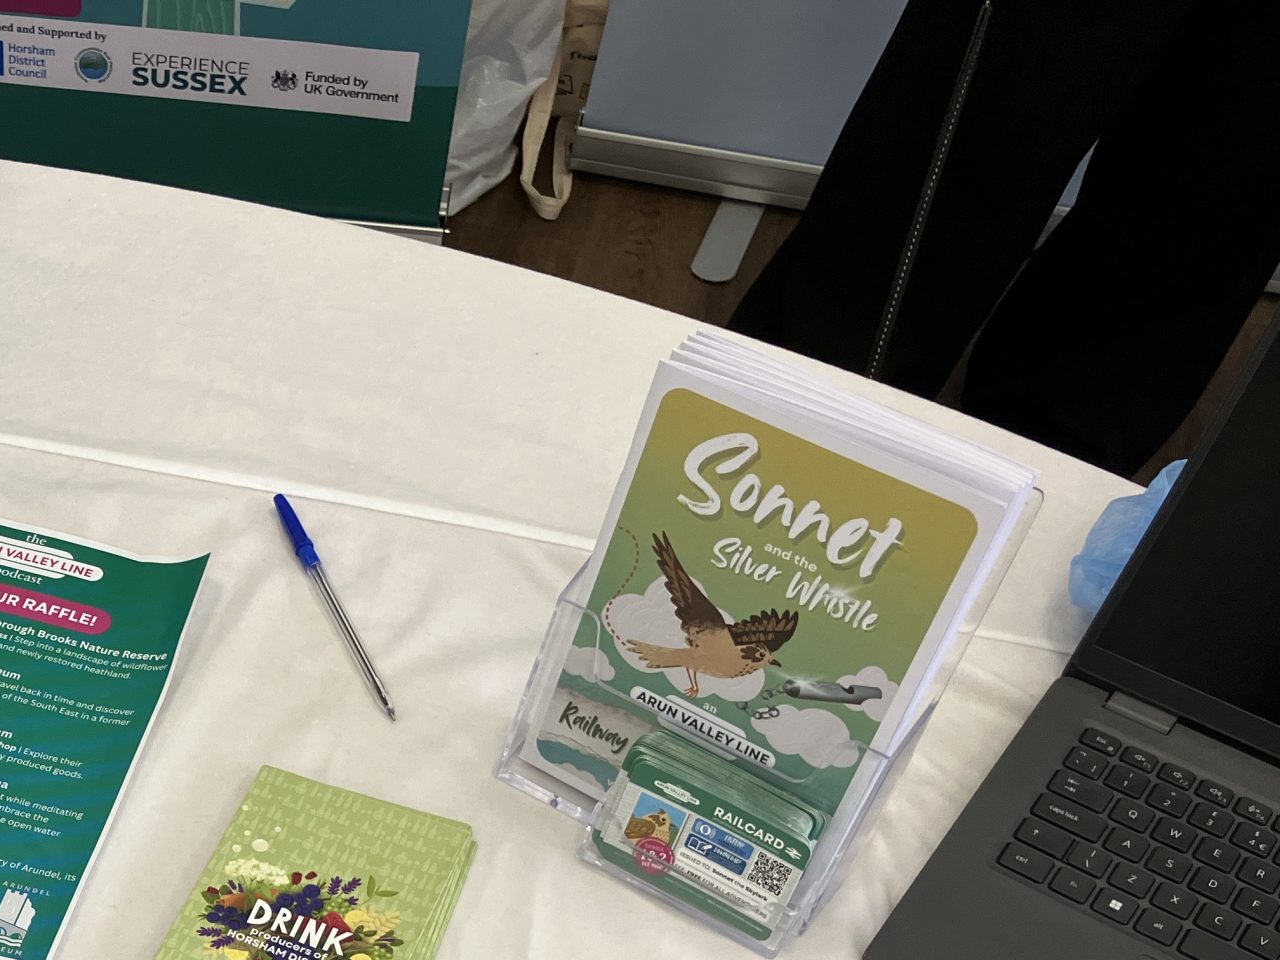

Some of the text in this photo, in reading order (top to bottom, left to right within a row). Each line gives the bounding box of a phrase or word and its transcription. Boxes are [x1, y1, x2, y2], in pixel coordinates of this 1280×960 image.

[132, 52, 249, 76] EXPERIENCE
[132, 67, 248, 95] SUSSEX
[304, 83, 399, 103] UK Government
[305, 71, 368, 90] Funded by
[677, 432, 903, 578] Sonnet
[711, 537, 782, 584] Silver
[764, 543, 817, 572] and the
[22, 598, 97, 626] RAFFLE!
[785, 572, 878, 632] Whistle
[559, 701, 629, 753] Railway
[633, 690, 769, 765] ARUN VALLEY LINE
[714, 807, 784, 849] RAILCARD
[1065, 811, 1078, 821] lock
[1129, 810, 1137, 819] Q
[1016, 855, 1028, 863] ctrl
[247, 899, 353, 956] DRINK
[227, 930, 286, 960] HORSHAM
[249, 928, 328, 960] producers of
